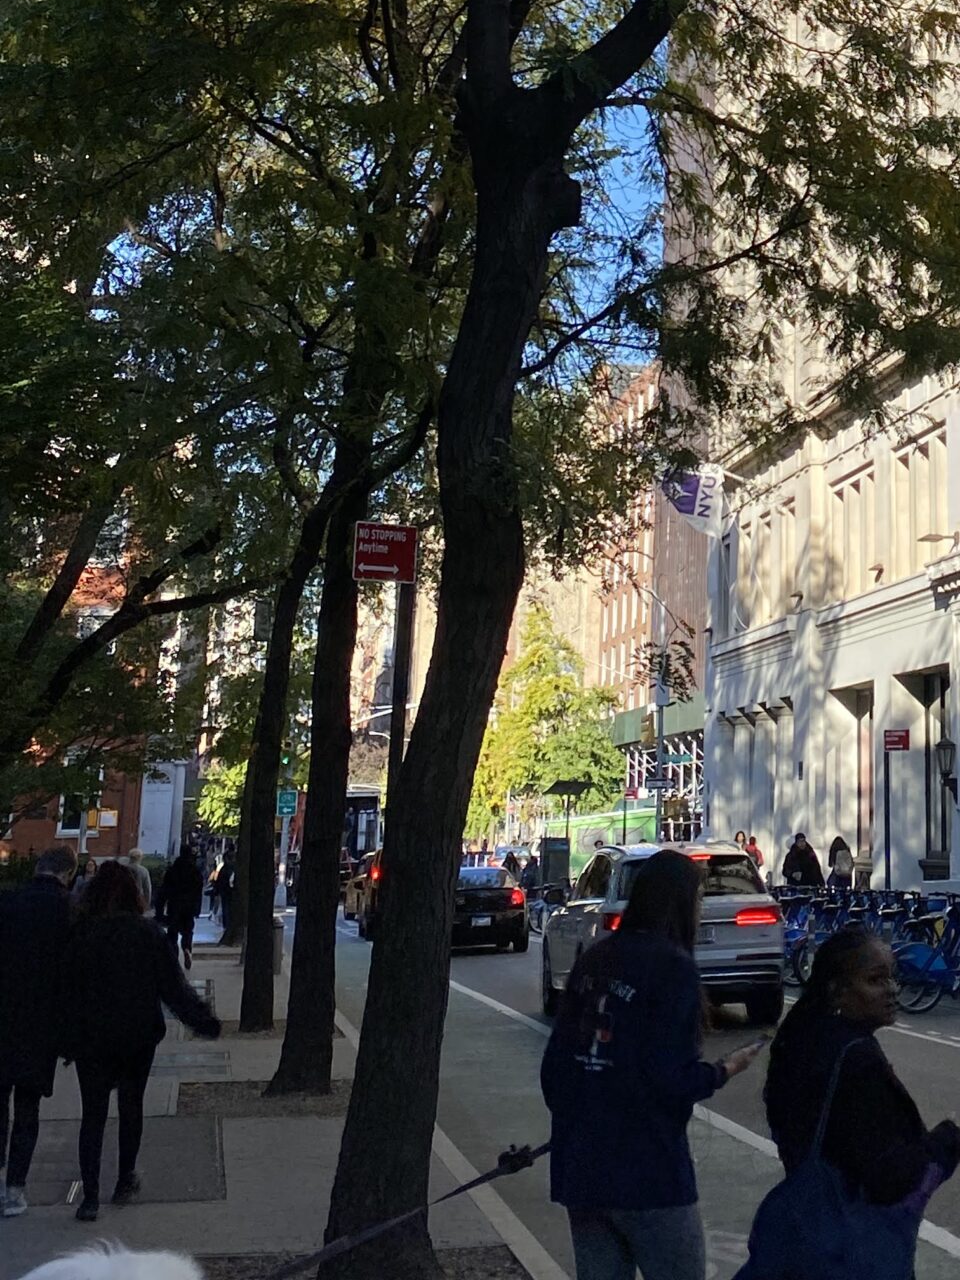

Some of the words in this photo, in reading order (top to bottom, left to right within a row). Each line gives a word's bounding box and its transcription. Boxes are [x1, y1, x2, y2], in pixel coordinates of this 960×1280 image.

[697, 476, 717, 518] NYU
[359, 528, 369, 539] NO
[371, 529, 407, 542] STOPPING
[358, 541, 389, 554] Anytime
